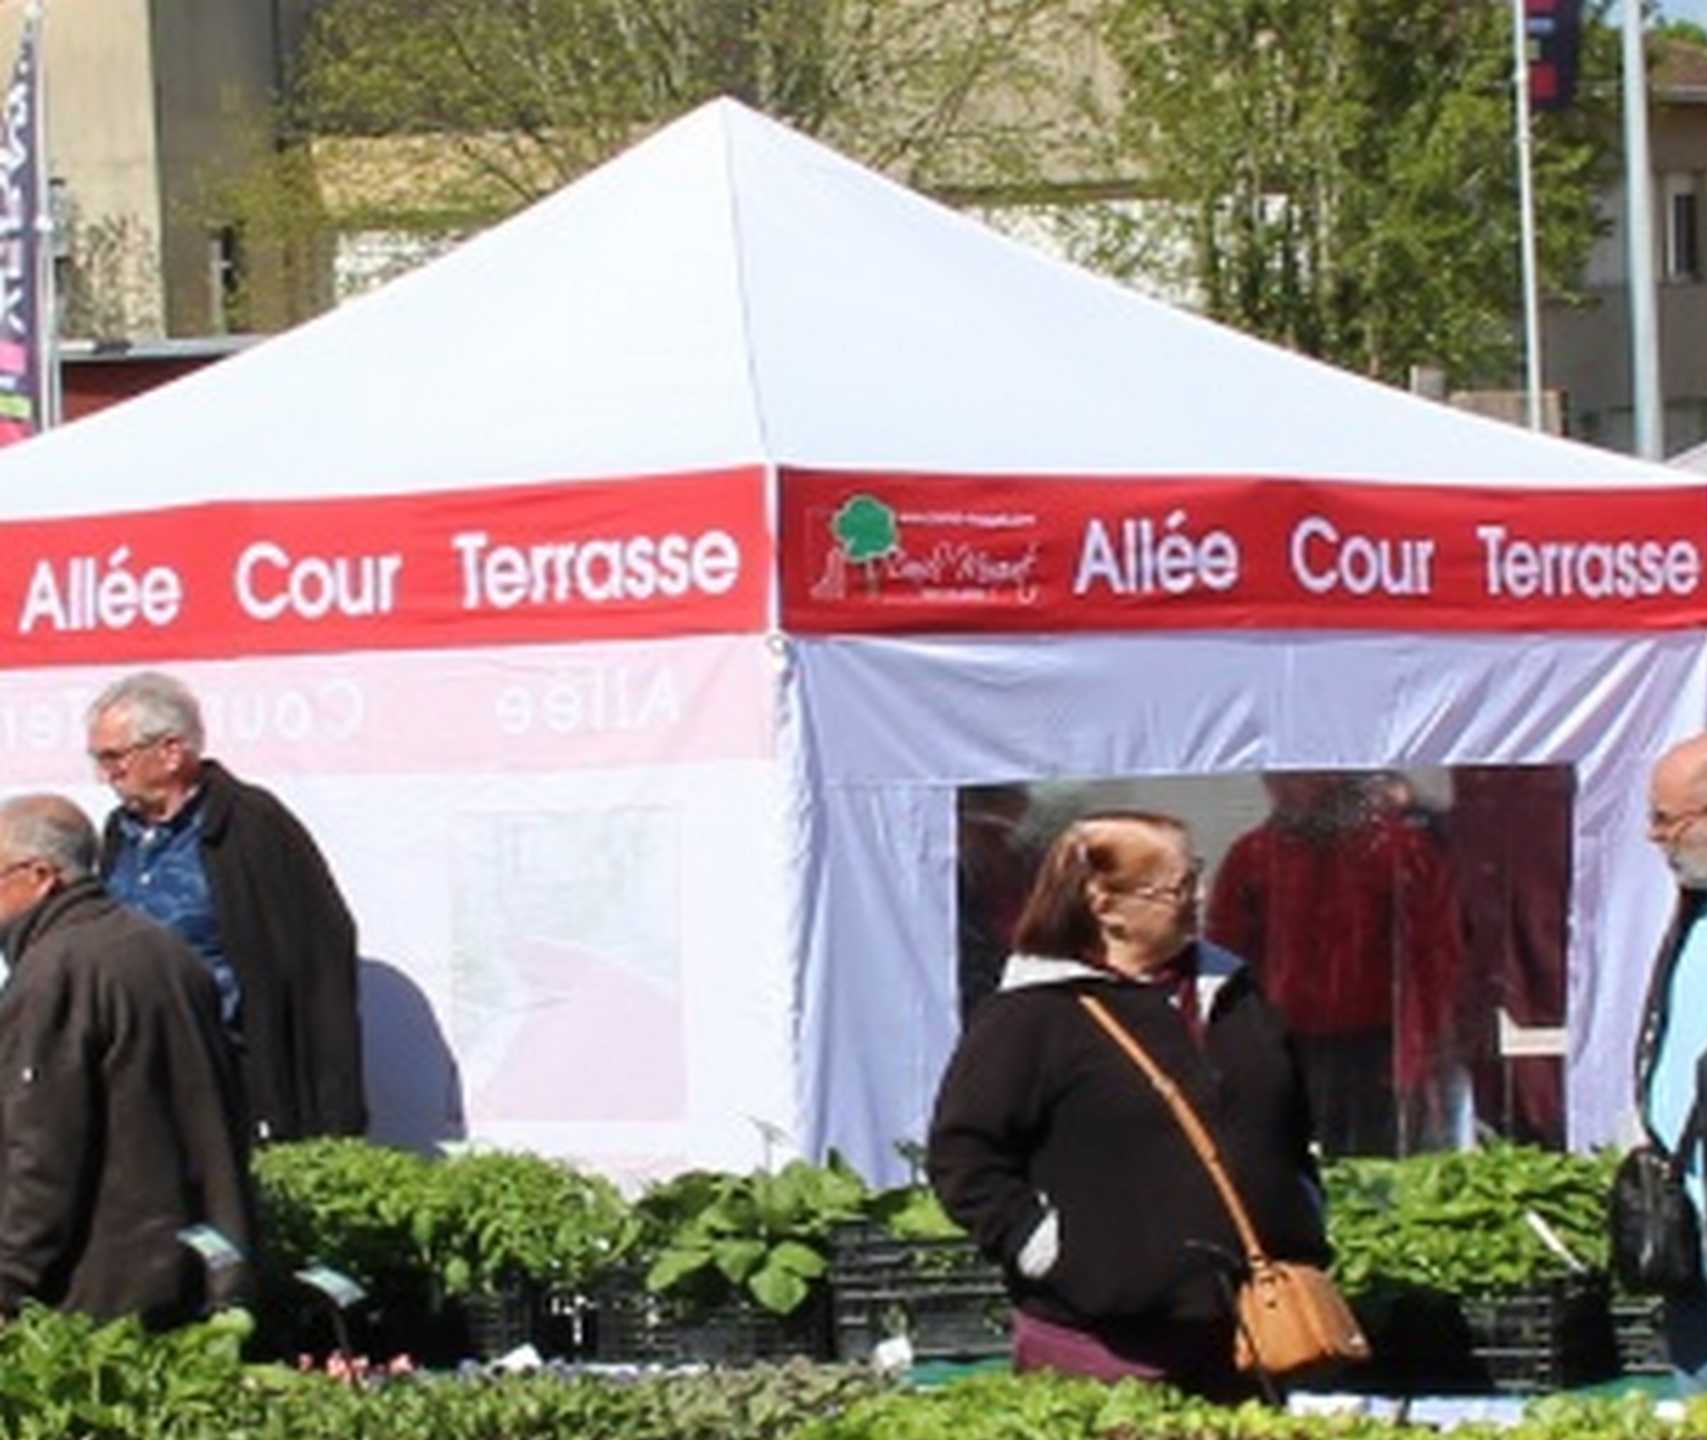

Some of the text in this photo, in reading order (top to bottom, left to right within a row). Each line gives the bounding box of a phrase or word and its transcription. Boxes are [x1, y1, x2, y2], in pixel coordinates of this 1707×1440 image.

[19, 528, 740, 632] Allée Cour Terrasse
[1074, 509, 1240, 595] Allée
[1290, 517, 1435, 597] Cour
[1478, 524, 1701, 597] Terrasse
